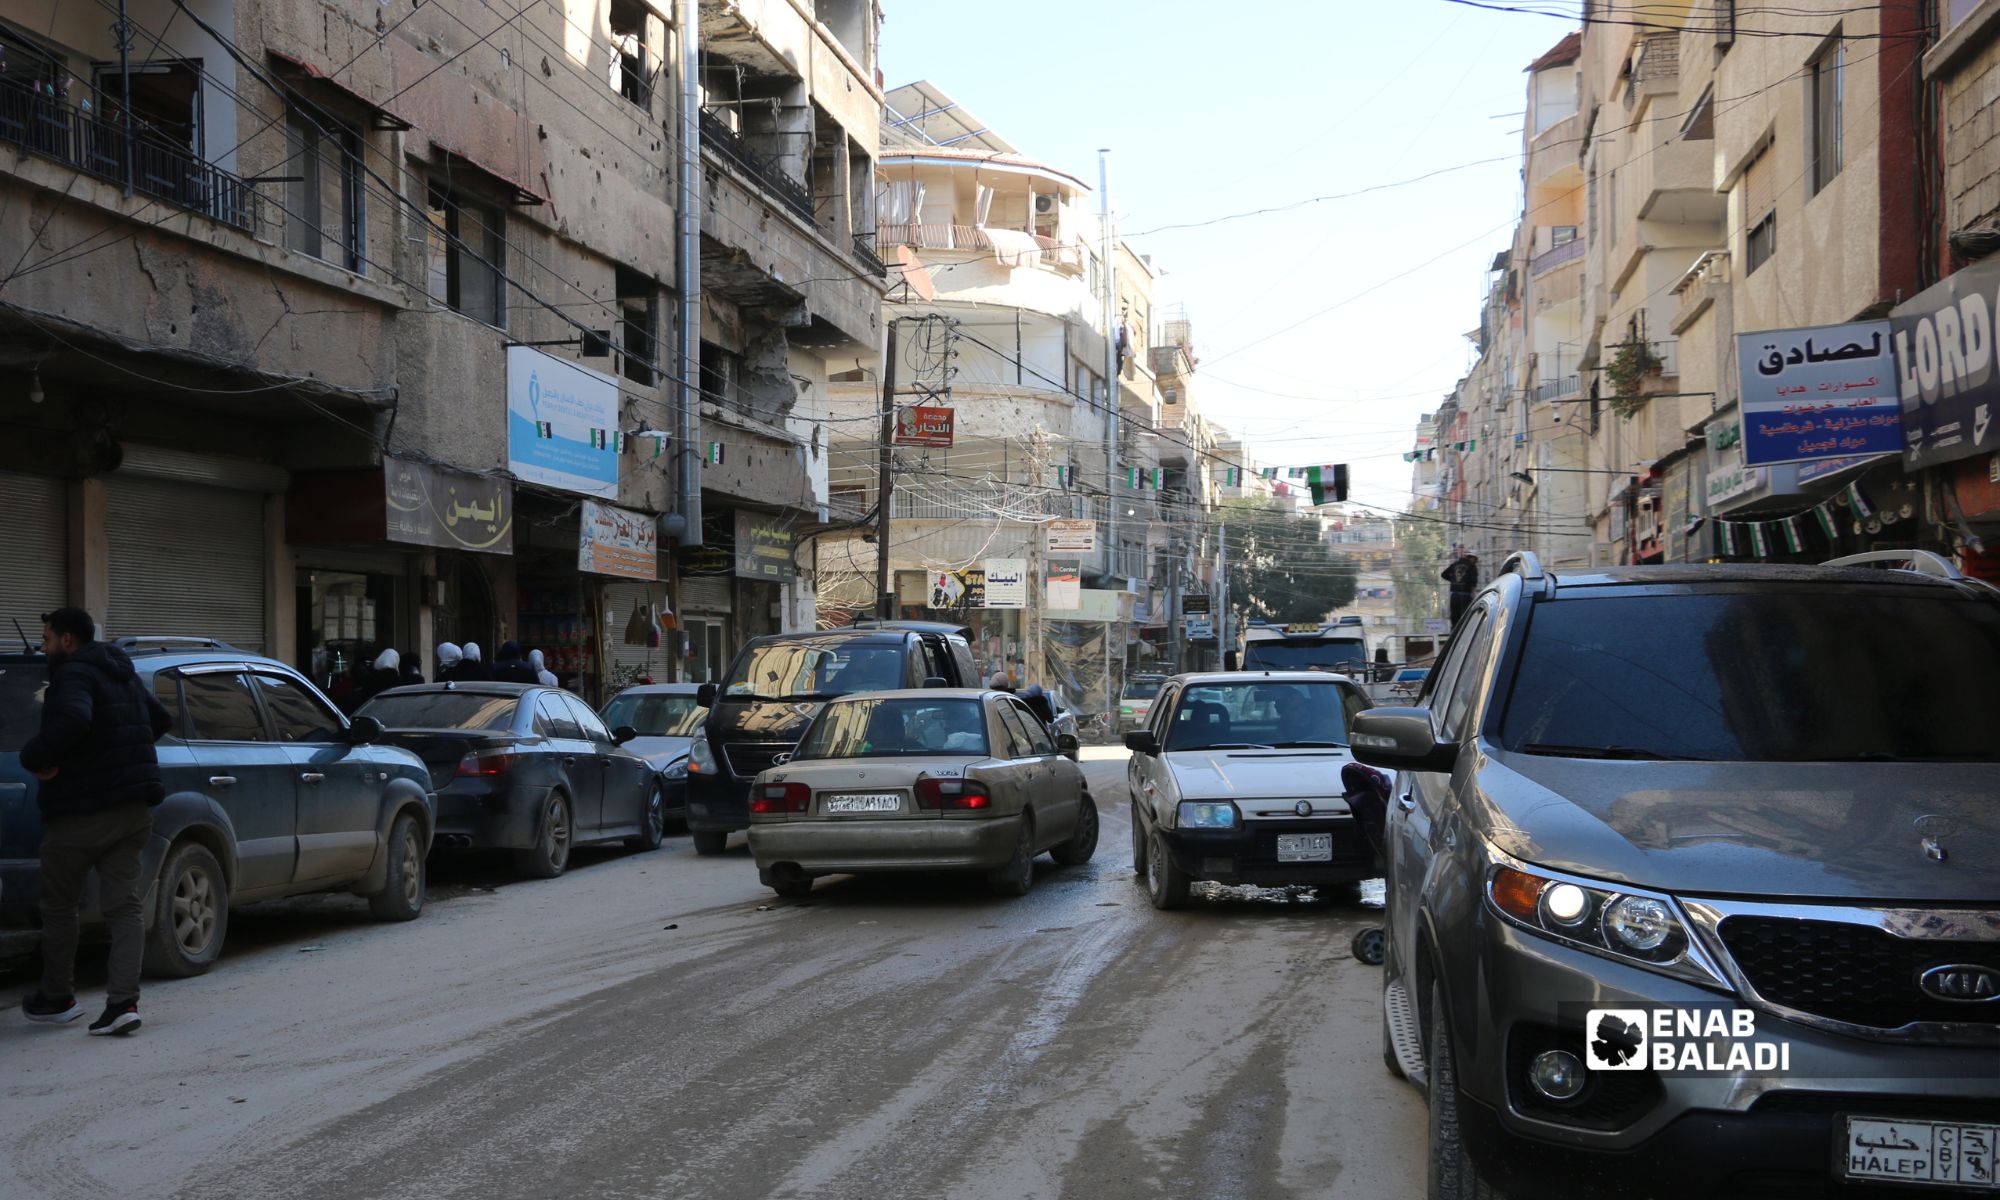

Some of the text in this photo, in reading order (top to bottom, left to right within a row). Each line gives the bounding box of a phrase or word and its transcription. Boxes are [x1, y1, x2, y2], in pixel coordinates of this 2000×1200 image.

[1896, 293, 1991, 403] LORD
[1776, 385, 1807, 397] هدايا
[918, 422, 950, 434] النجار
[1759, 419, 1815, 437] قرطاسية
[1824, 416, 1867, 431] منزلية
[1797, 436, 1867, 453] مواد تجميل
[446, 485, 503, 534] أيمن
[987, 572, 1023, 586] البيك
[1937, 972, 1995, 993] KIA
[1855, 1126, 1919, 1154] حلب
[1851, 1155, 1926, 1175] HALEP
